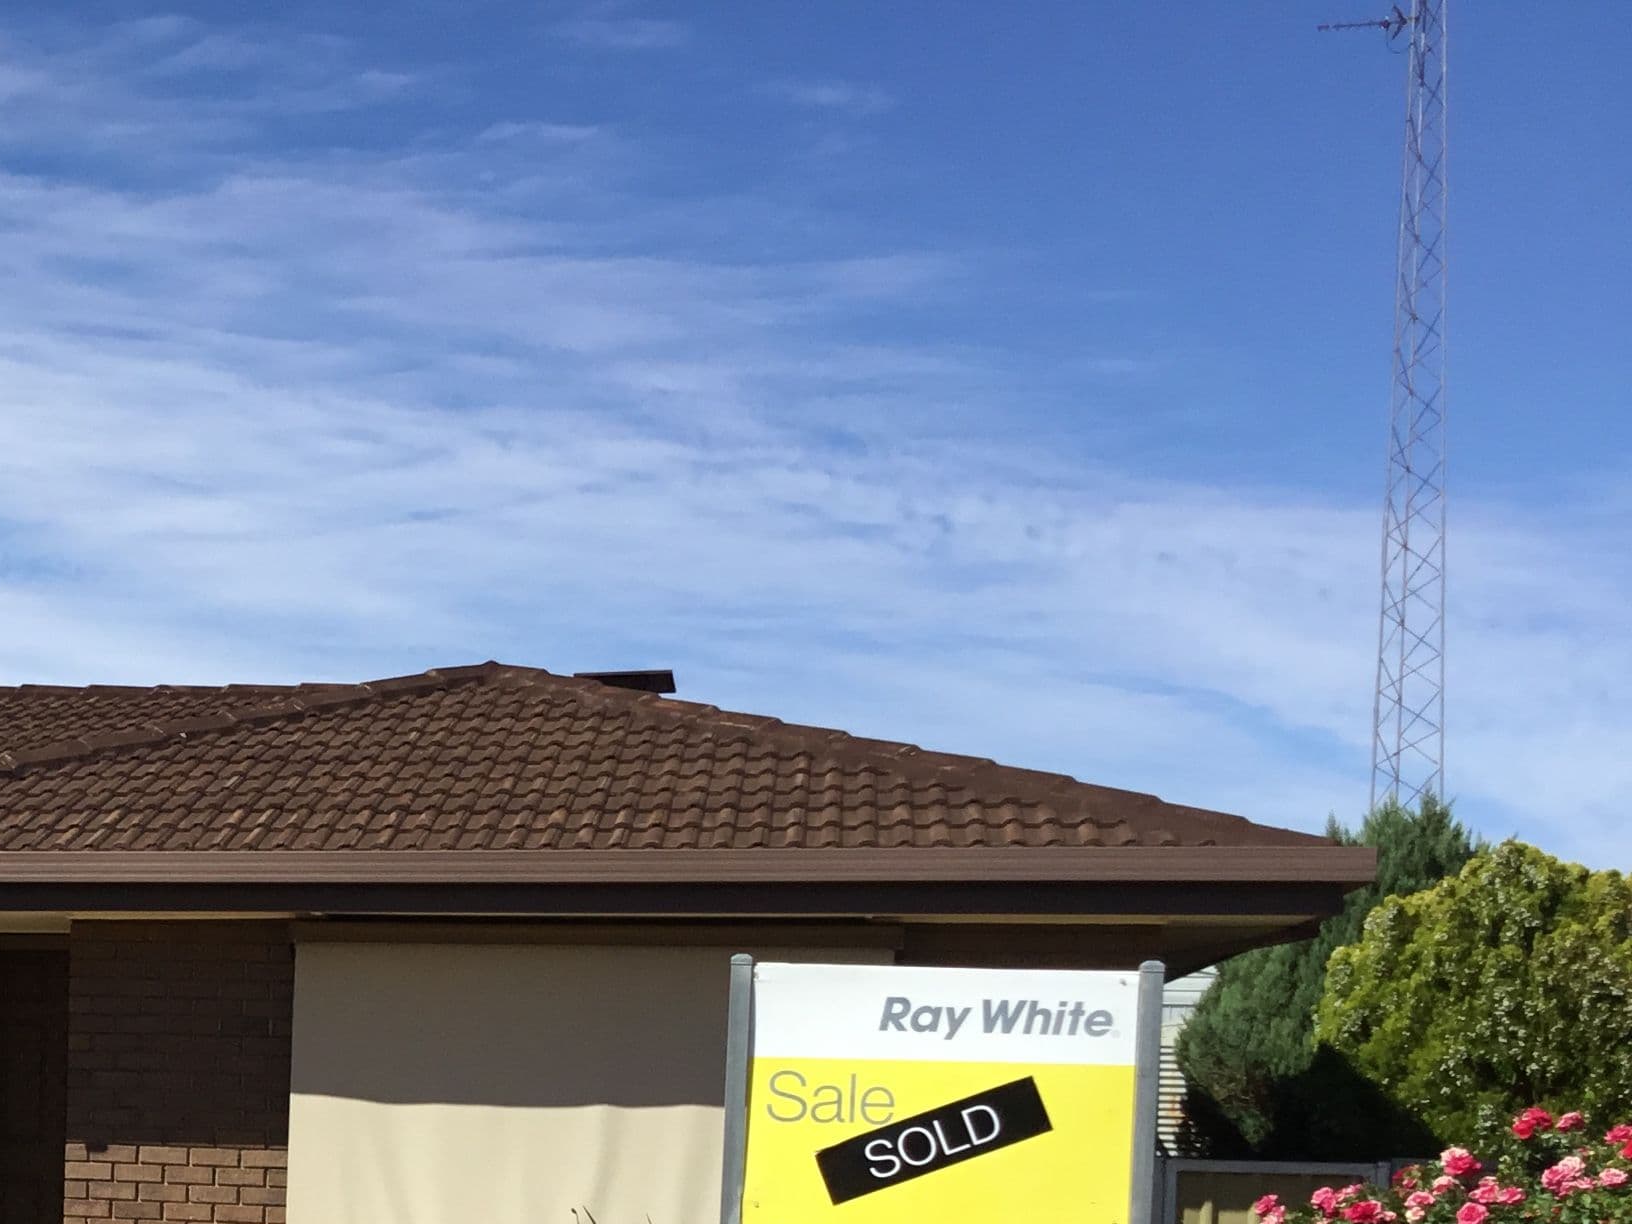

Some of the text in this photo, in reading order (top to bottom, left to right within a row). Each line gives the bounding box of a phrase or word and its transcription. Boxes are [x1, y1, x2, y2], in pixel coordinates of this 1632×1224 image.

[879, 996, 1114, 1040] Ray White
[767, 1070, 896, 1126] Sale
[865, 1104, 1001, 1178] SOLD
